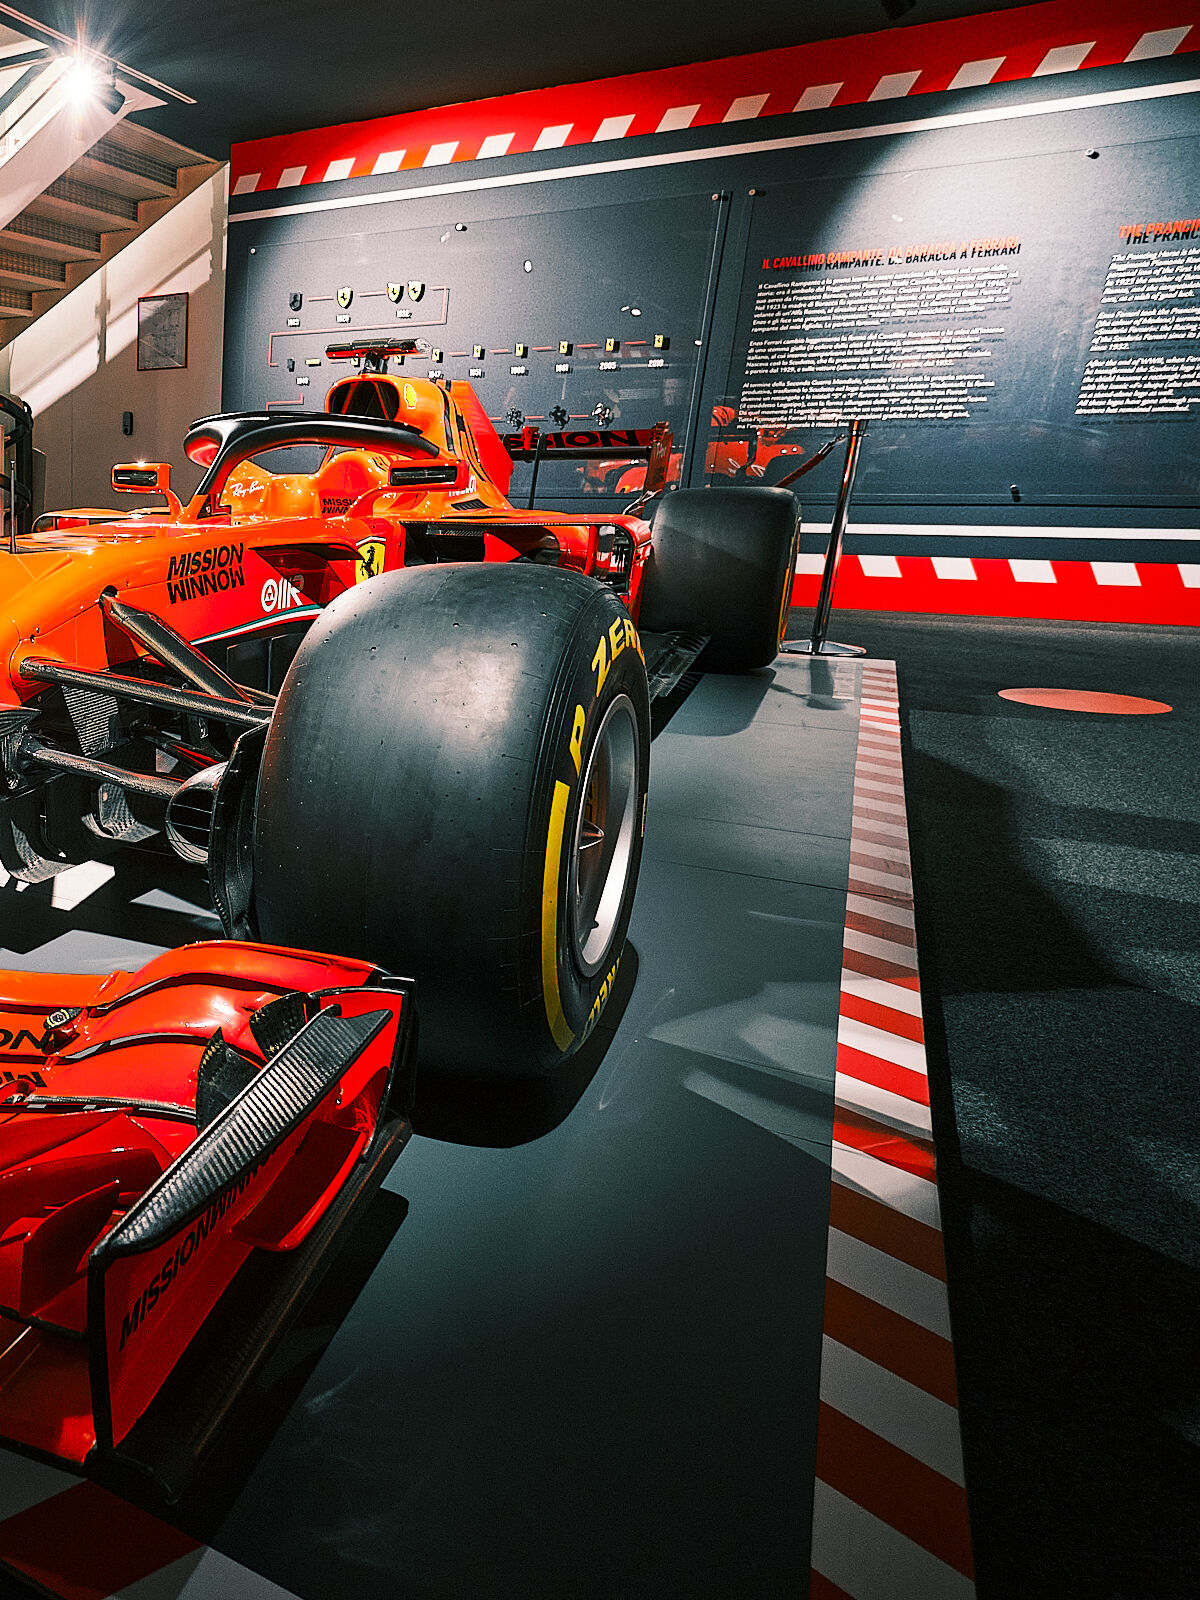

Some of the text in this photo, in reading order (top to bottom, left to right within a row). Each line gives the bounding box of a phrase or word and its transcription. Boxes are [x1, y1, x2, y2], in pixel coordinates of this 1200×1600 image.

[1119, 225, 1144, 239] THE
[762, 259, 770, 269] IL
[773, 254, 825, 269] CAVALLINO
[905, 242, 956, 258] BARACCA
[969, 236, 1019, 252] FERRARI
[230, 480, 265, 498] Ray-Ban
[168, 543, 244, 579] MISSION
[166, 566, 246, 604] WINNOW
[569, 704, 586, 778] P
[119, 1208, 211, 1352] MISSION
